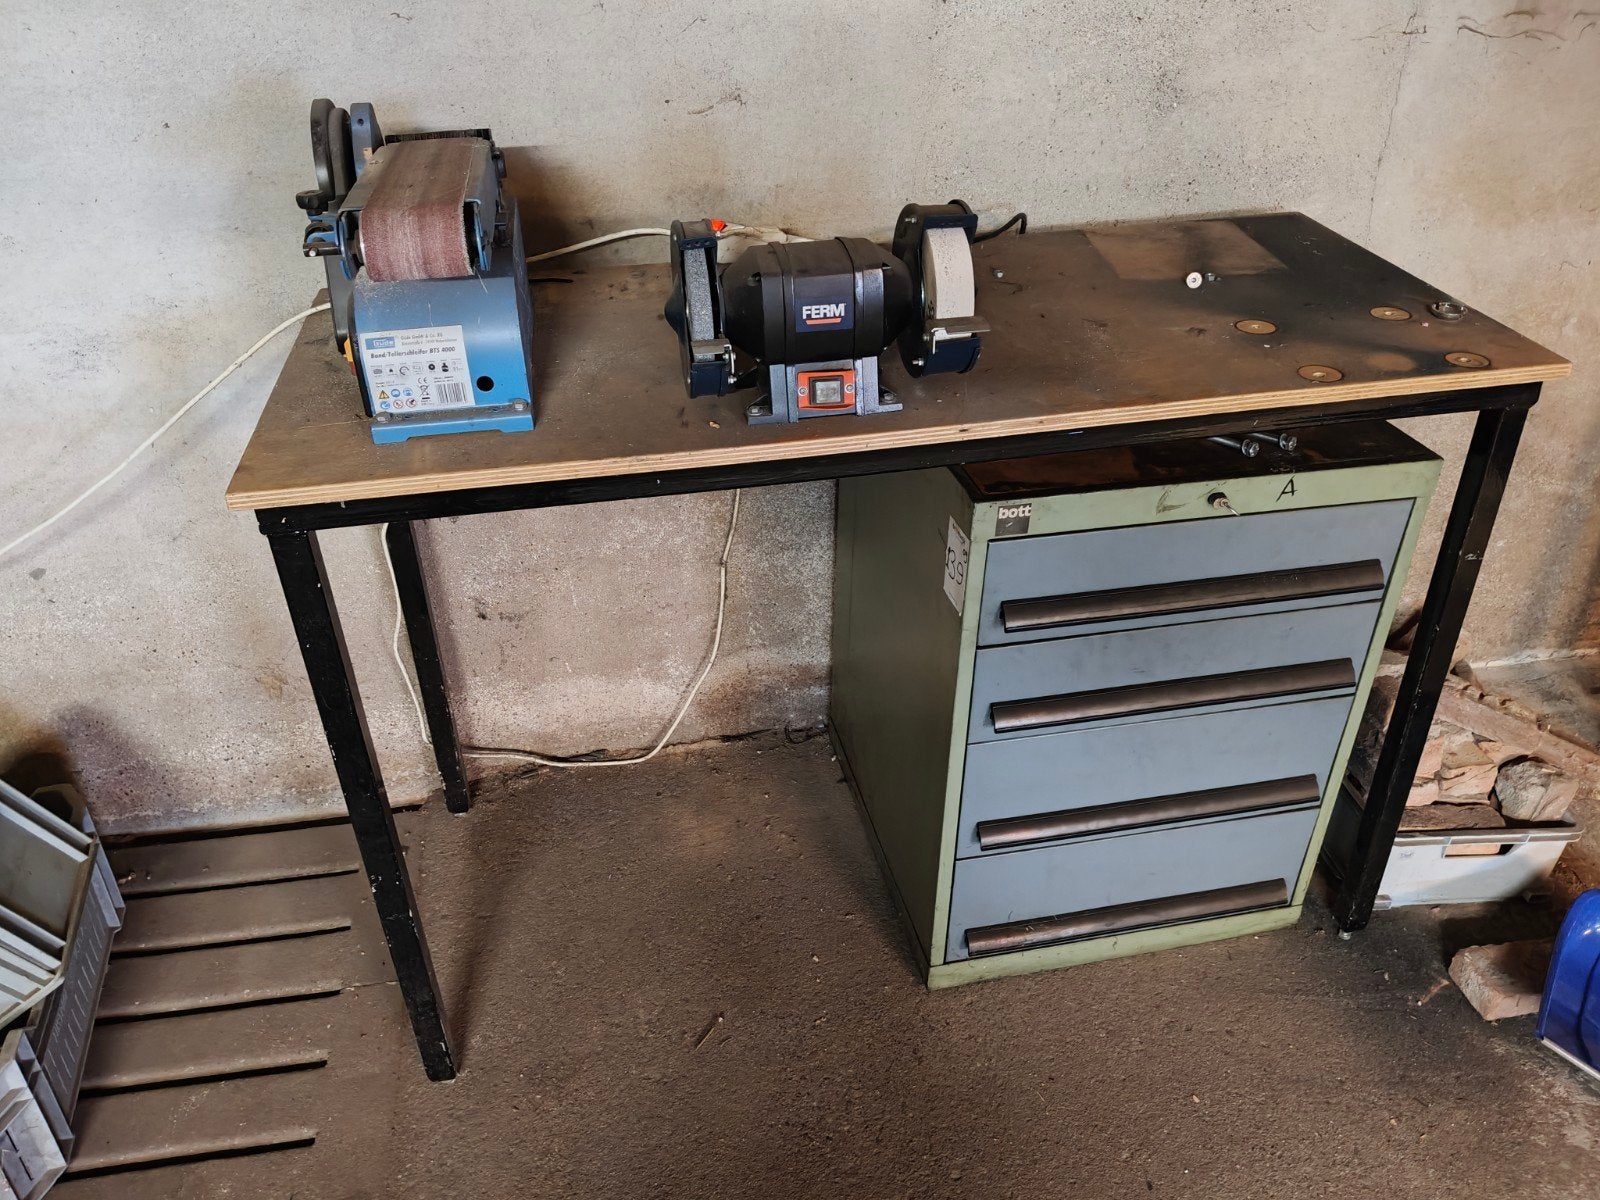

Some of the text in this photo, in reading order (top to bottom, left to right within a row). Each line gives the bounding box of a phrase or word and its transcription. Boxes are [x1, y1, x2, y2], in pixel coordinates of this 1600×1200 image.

[802, 303, 845, 320] FERM
[1276, 475, 1298, 502] A
[998, 504, 1032, 519] bott
